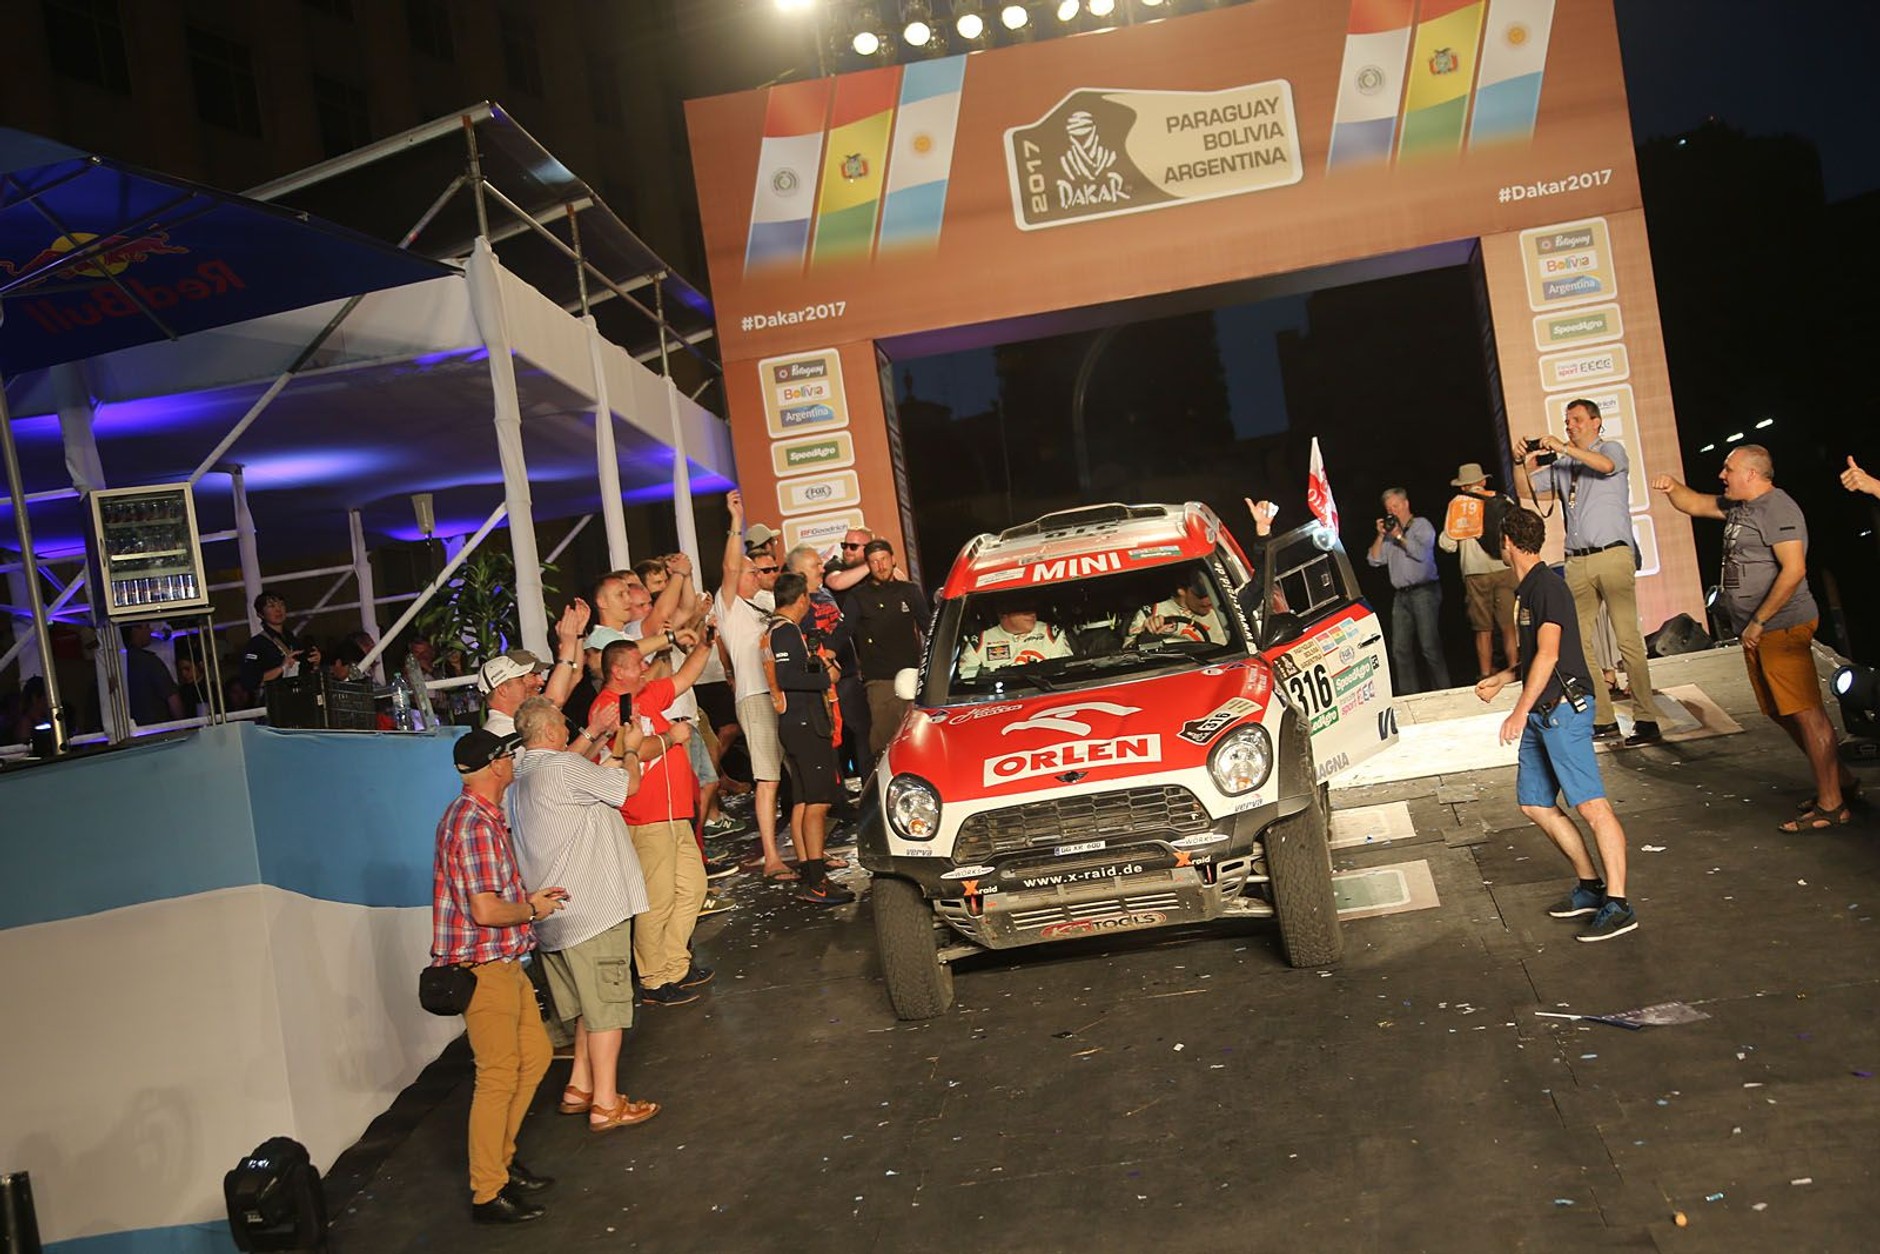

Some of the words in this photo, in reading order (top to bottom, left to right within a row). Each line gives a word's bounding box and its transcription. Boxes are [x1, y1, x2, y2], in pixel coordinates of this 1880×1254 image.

[1166, 96, 1280, 133] PARAGUAY
[1203, 121, 1284, 151] BOLIVIA
[1023, 140, 1048, 214] 2017
[1164, 147, 1287, 184] ARGENTINA
[1056, 172, 1130, 209] DAKAR
[1498, 168, 1613, 203] #Dakar2017
[1547, 255, 1590, 272] Bolivia
[1549, 279, 1596, 295] Argentina
[741, 300, 847, 331] #Dakar2017
[784, 385, 824, 400] Bolivia
[786, 406, 829, 422] Argentina
[1461, 502, 1477, 515] 19
[1032, 552, 1122, 582] MINI
[1289, 664, 1332, 717] 316
[1201, 712, 1231, 729] 316
[993, 738, 1148, 776] ORLEN
[1316, 752, 1350, 779] AGNA
[1185, 834, 1214, 845] WORKS
[955, 868, 982, 878] WORKS
[1023, 864, 1143, 888] www.x-raid.de
